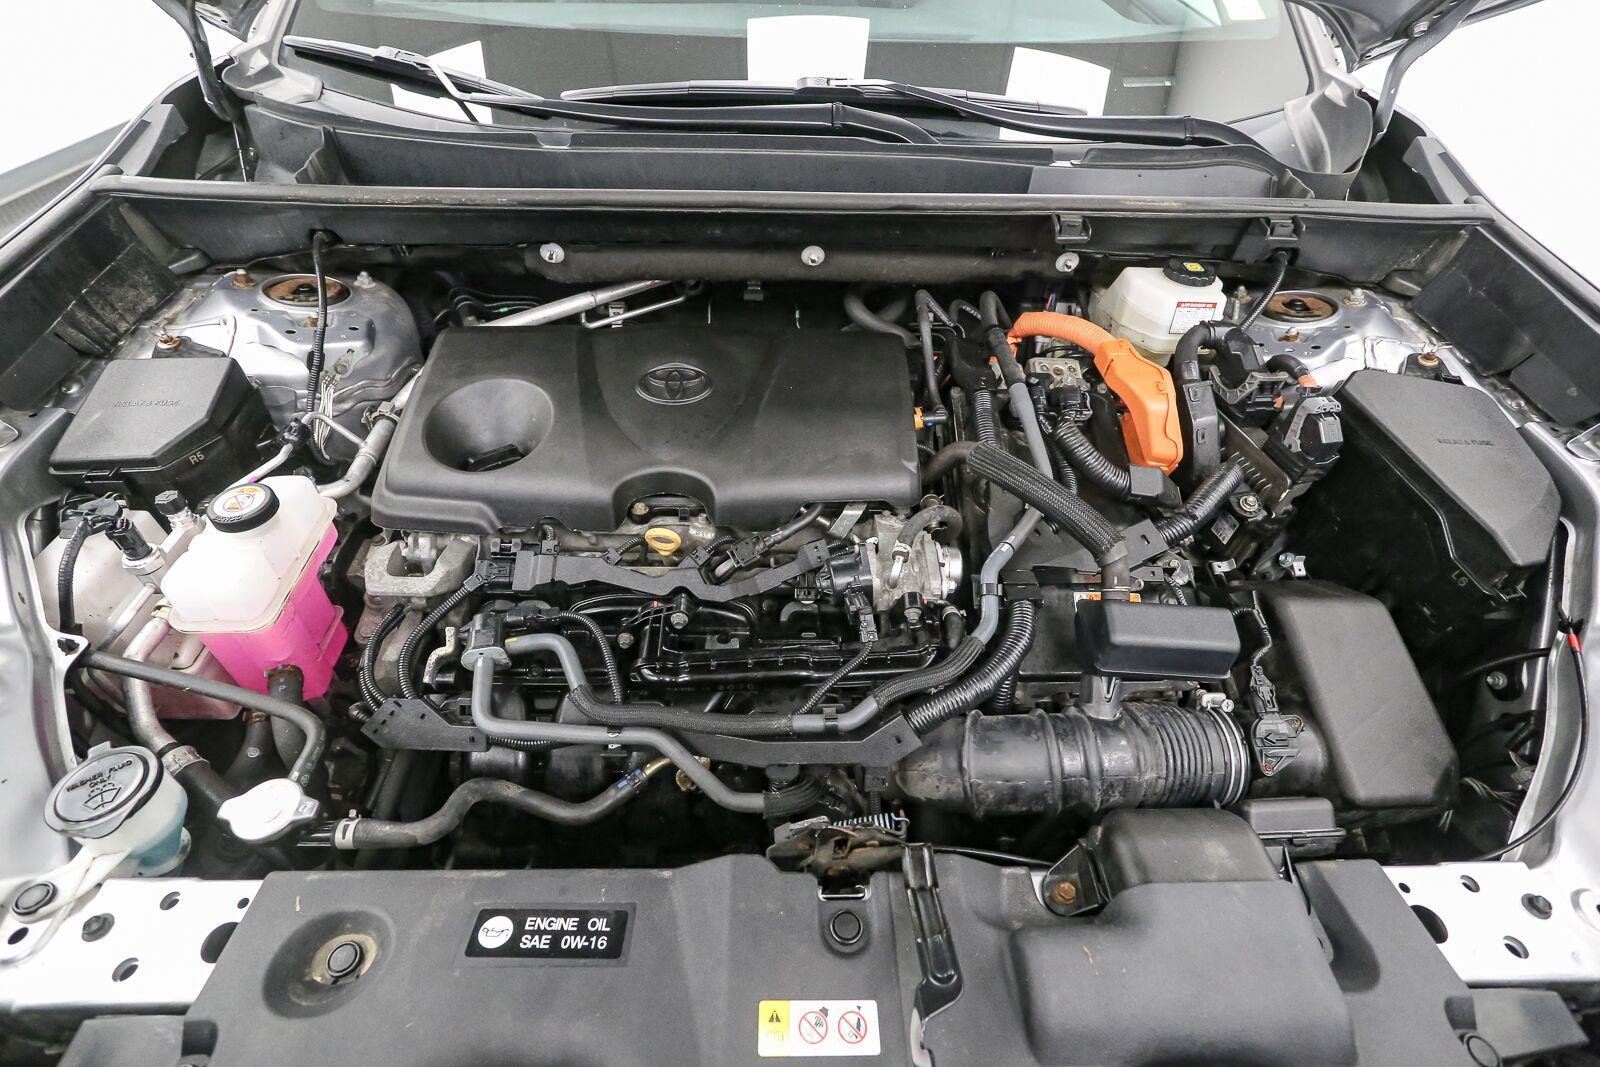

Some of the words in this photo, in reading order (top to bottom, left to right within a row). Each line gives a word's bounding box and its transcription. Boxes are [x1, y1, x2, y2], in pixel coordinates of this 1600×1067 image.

[108, 759, 133, 774] FLUID
[89, 774, 112, 788] ONLY
[524, 917, 579, 931] ENGINE
[587, 917, 611, 932] OIL
[519, 934, 552, 949] SAE
[560, 935, 608, 950] 0W-16
